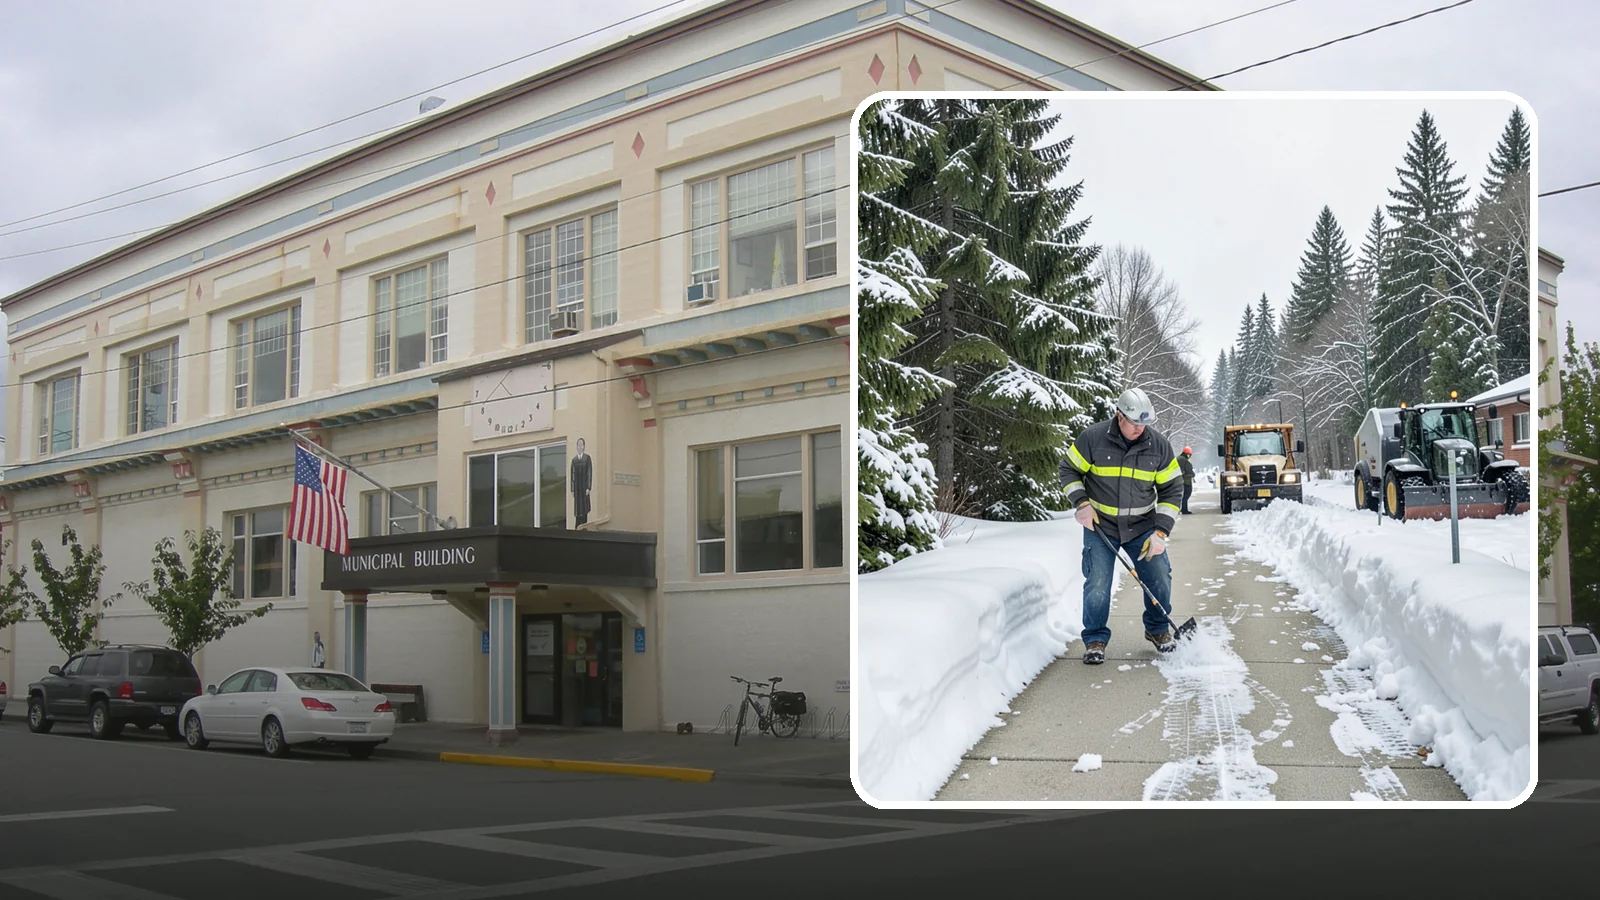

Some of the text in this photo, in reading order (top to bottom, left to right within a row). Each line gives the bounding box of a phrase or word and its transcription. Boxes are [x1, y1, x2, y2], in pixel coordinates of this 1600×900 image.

[480, 406, 485, 415] 8
[487, 417, 492, 426] 9
[494, 423, 501, 432] 10
[507, 425, 513, 433] 12
[342, 546, 475, 571] MUNICIPAL BUILDING
